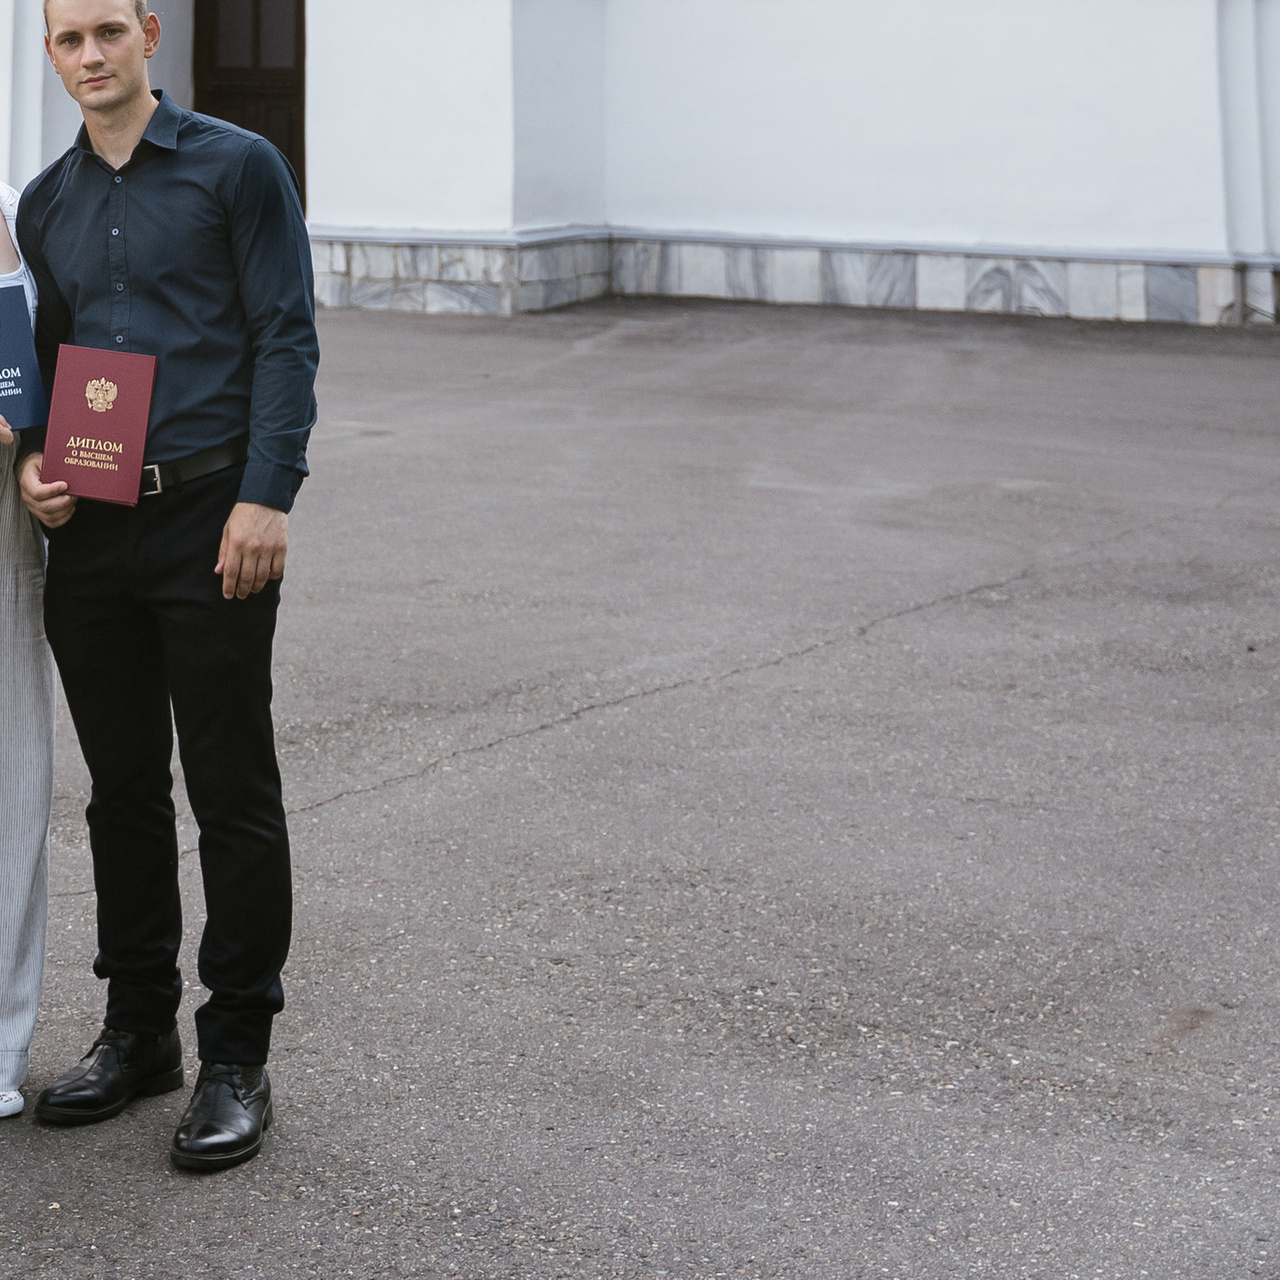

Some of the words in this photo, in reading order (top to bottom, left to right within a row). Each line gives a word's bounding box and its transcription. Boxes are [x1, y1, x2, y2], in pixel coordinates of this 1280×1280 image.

[66, 436, 123, 453] ДИПЛОМ
[80, 450, 113, 462] ВЫСШЕМ
[64, 457, 119, 471] ОБРАЗОВАНИИ
